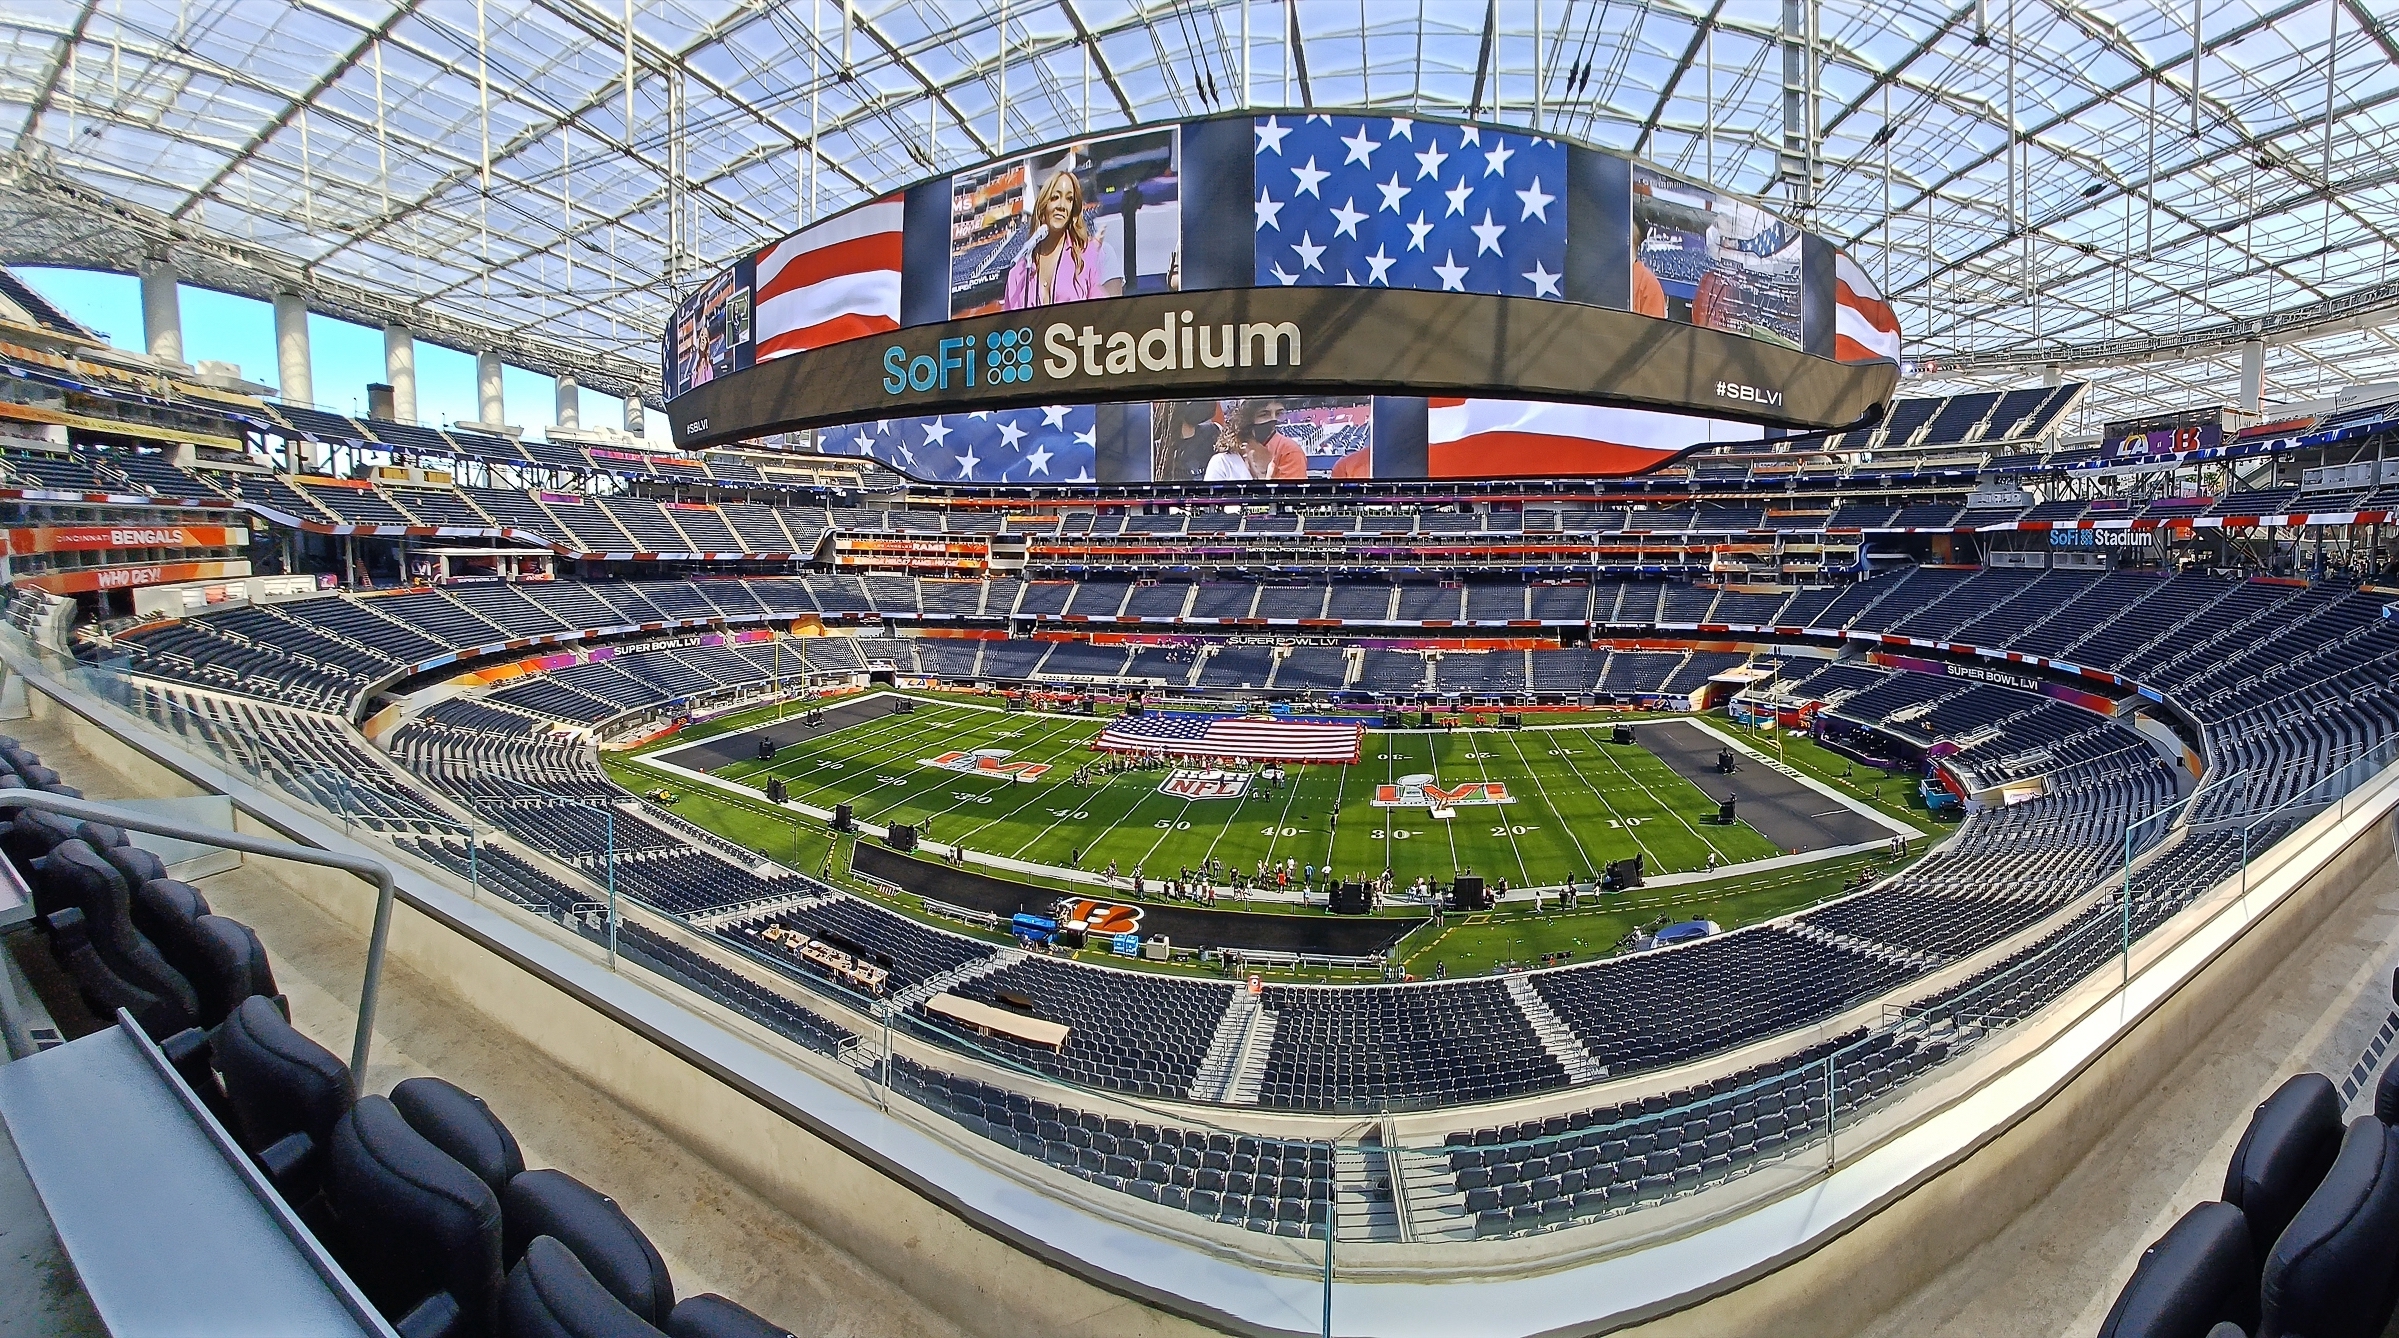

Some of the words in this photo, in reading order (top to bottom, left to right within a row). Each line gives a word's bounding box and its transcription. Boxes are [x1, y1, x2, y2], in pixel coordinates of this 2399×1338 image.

[883, 335, 976, 395] SoFi
[1044, 310, 1301, 379] Stadium
[1715, 381, 1782, 407] #SBLVI
[56, 535, 110, 543] CINCINNATI
[111, 529, 184, 545] BENGALS
[2050, 529, 2078, 545] SoFi
[2095, 528, 2152, 546] Stadium
[912, 543, 946, 551] RAMS
[98, 571, 130, 587] WHO
[132, 567, 161, 584] DEY!
[614, 644, 651, 656] SUPER
[652, 639, 683, 651] BOWL
[684, 638, 701, 646] LVI
[1229, 637, 1275, 645] SUPER
[1276, 637, 1319, 646] BOWL
[1947, 665, 1984, 679] SUPER
[1986, 672, 2019, 686] BOWL
[2020, 678, 2038, 690] LVI
[1168, 780, 1235, 795] NFL
[1154, 820, 1191, 830] 50
[1260, 826, 1297, 837] 40
[1490, 825, 1526, 835] 20
[1604, 818, 1641, 830] 10
[1371, 829, 1410, 840] 30
